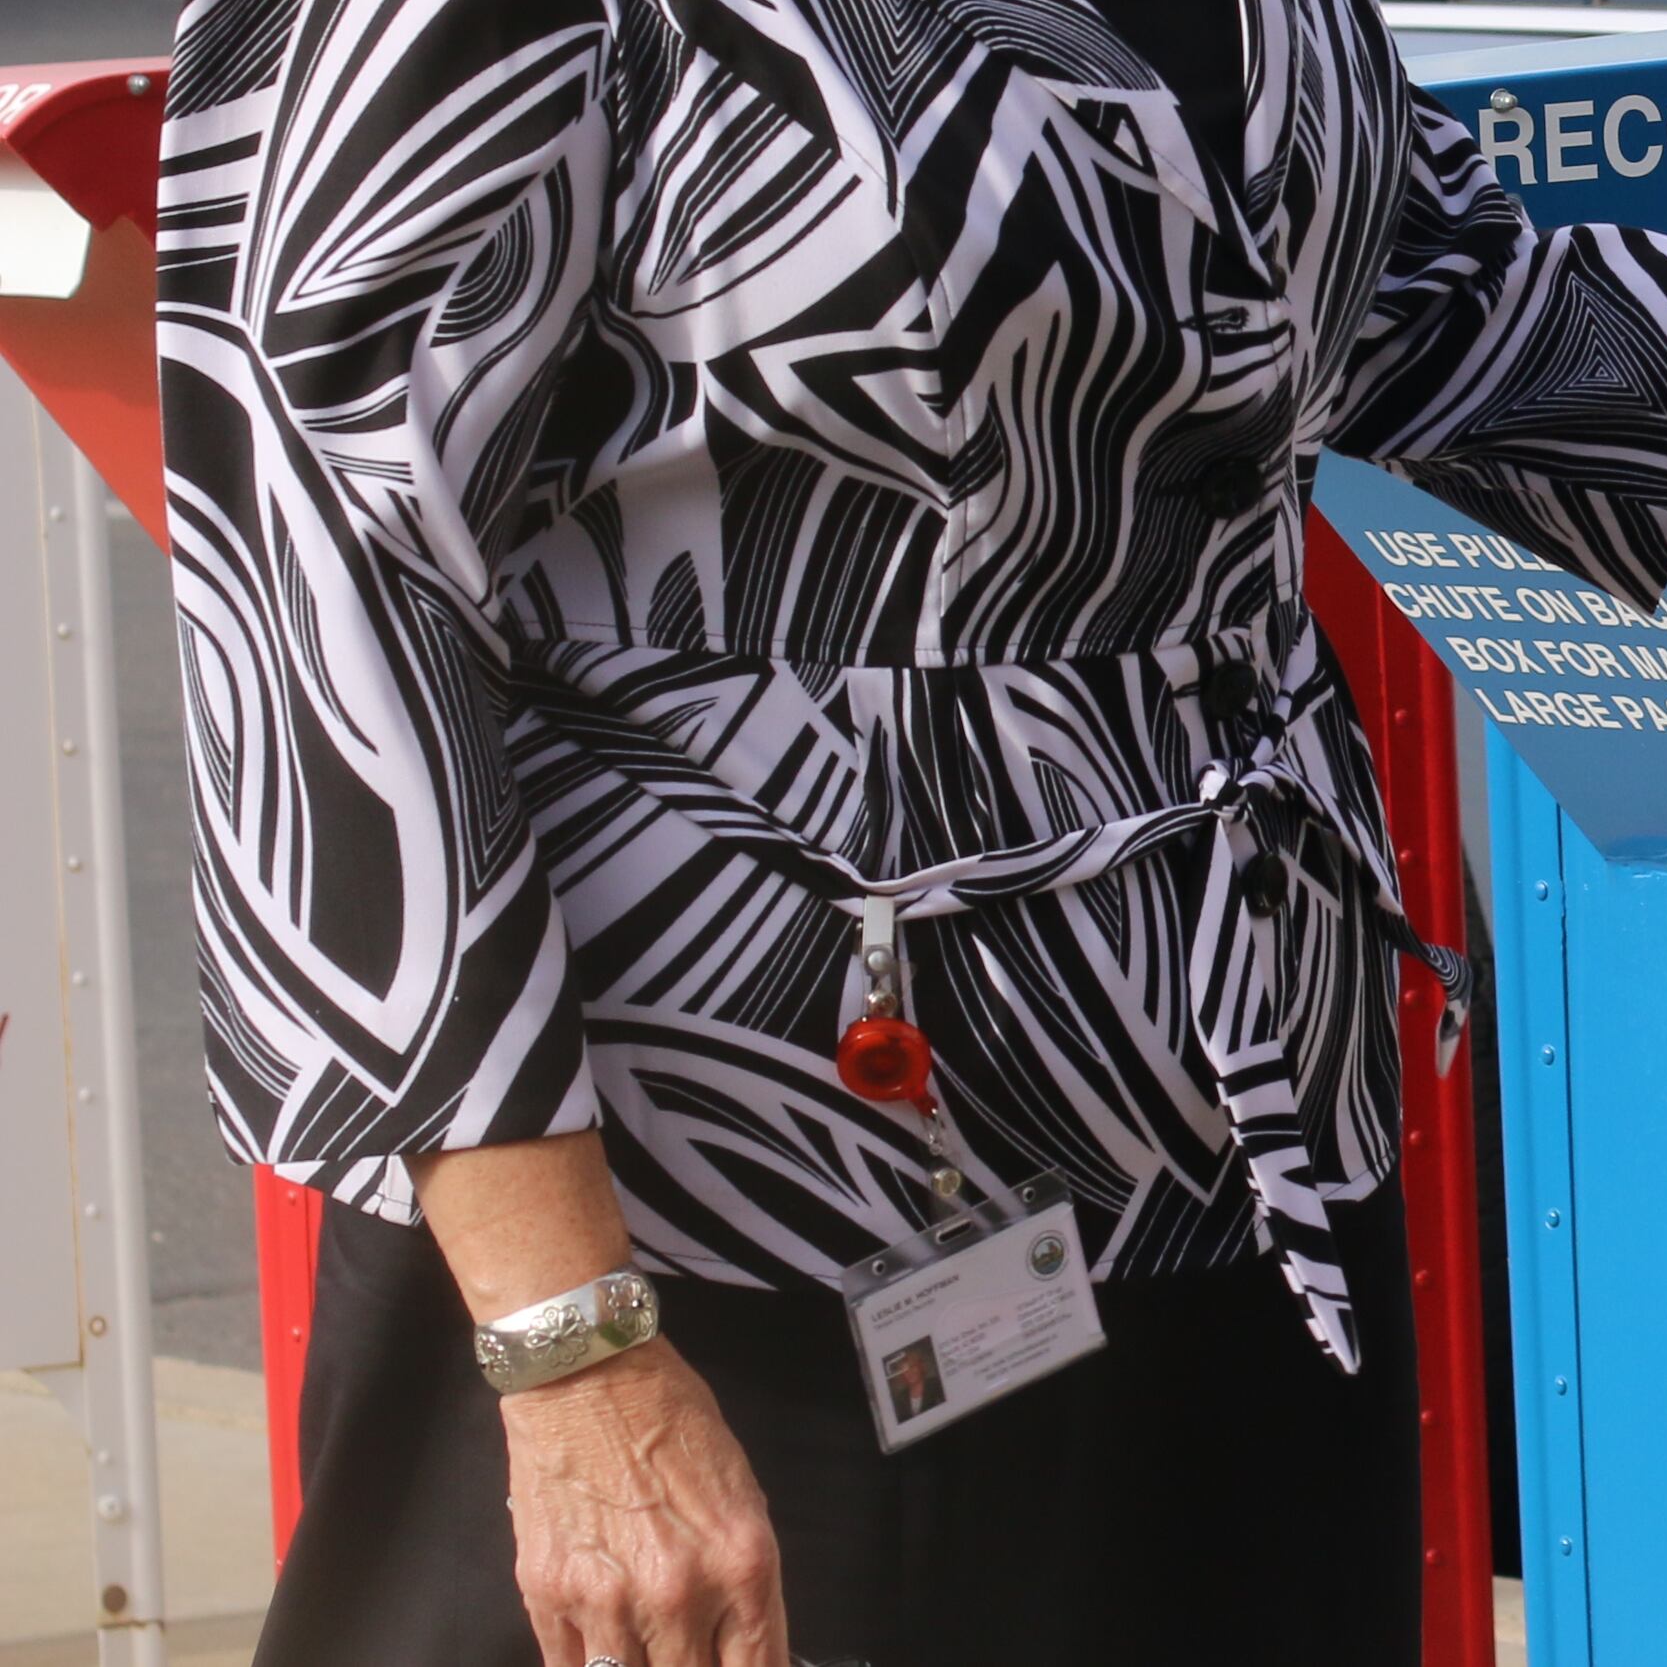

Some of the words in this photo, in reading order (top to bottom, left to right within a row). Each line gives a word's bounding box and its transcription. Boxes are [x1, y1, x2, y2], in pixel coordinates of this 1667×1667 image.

[1364, 531, 1461, 568] USE
[1383, 582, 1524, 623] CHUTE
[1515, 587, 1587, 625] ON
[1446, 636, 1543, 674] BOX
[1532, 639, 1629, 679] FOR
[1474, 687, 1621, 729] LARGE
